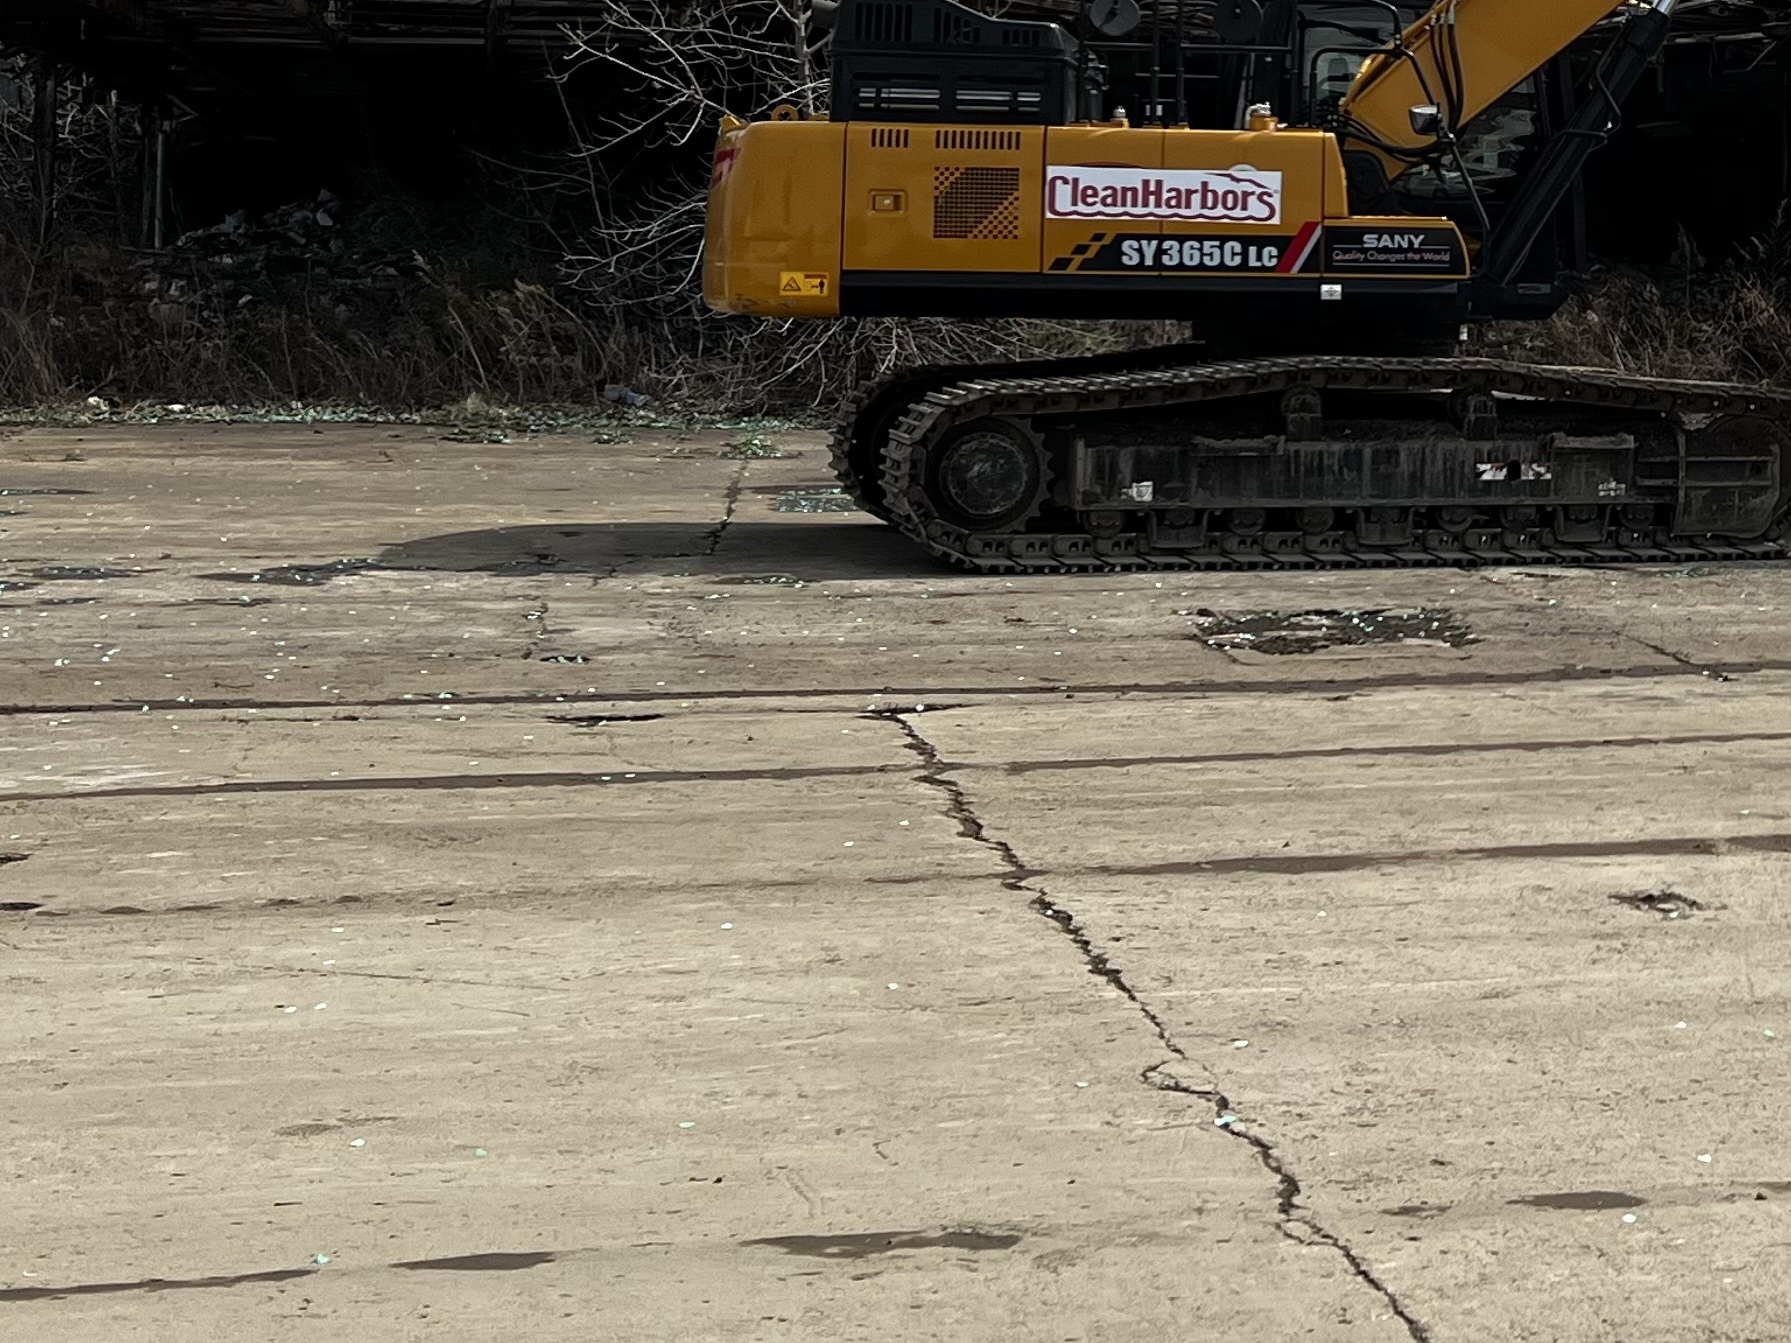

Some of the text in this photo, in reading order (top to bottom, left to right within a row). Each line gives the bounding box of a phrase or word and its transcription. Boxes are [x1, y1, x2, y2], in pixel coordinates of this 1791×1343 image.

[1048, 175, 1278, 222] CleanHarbors
[1363, 233, 1425, 249] SANY
[1248, 245, 1279, 268] LC
[1332, 250, 1451, 263] Quality Changes the World
